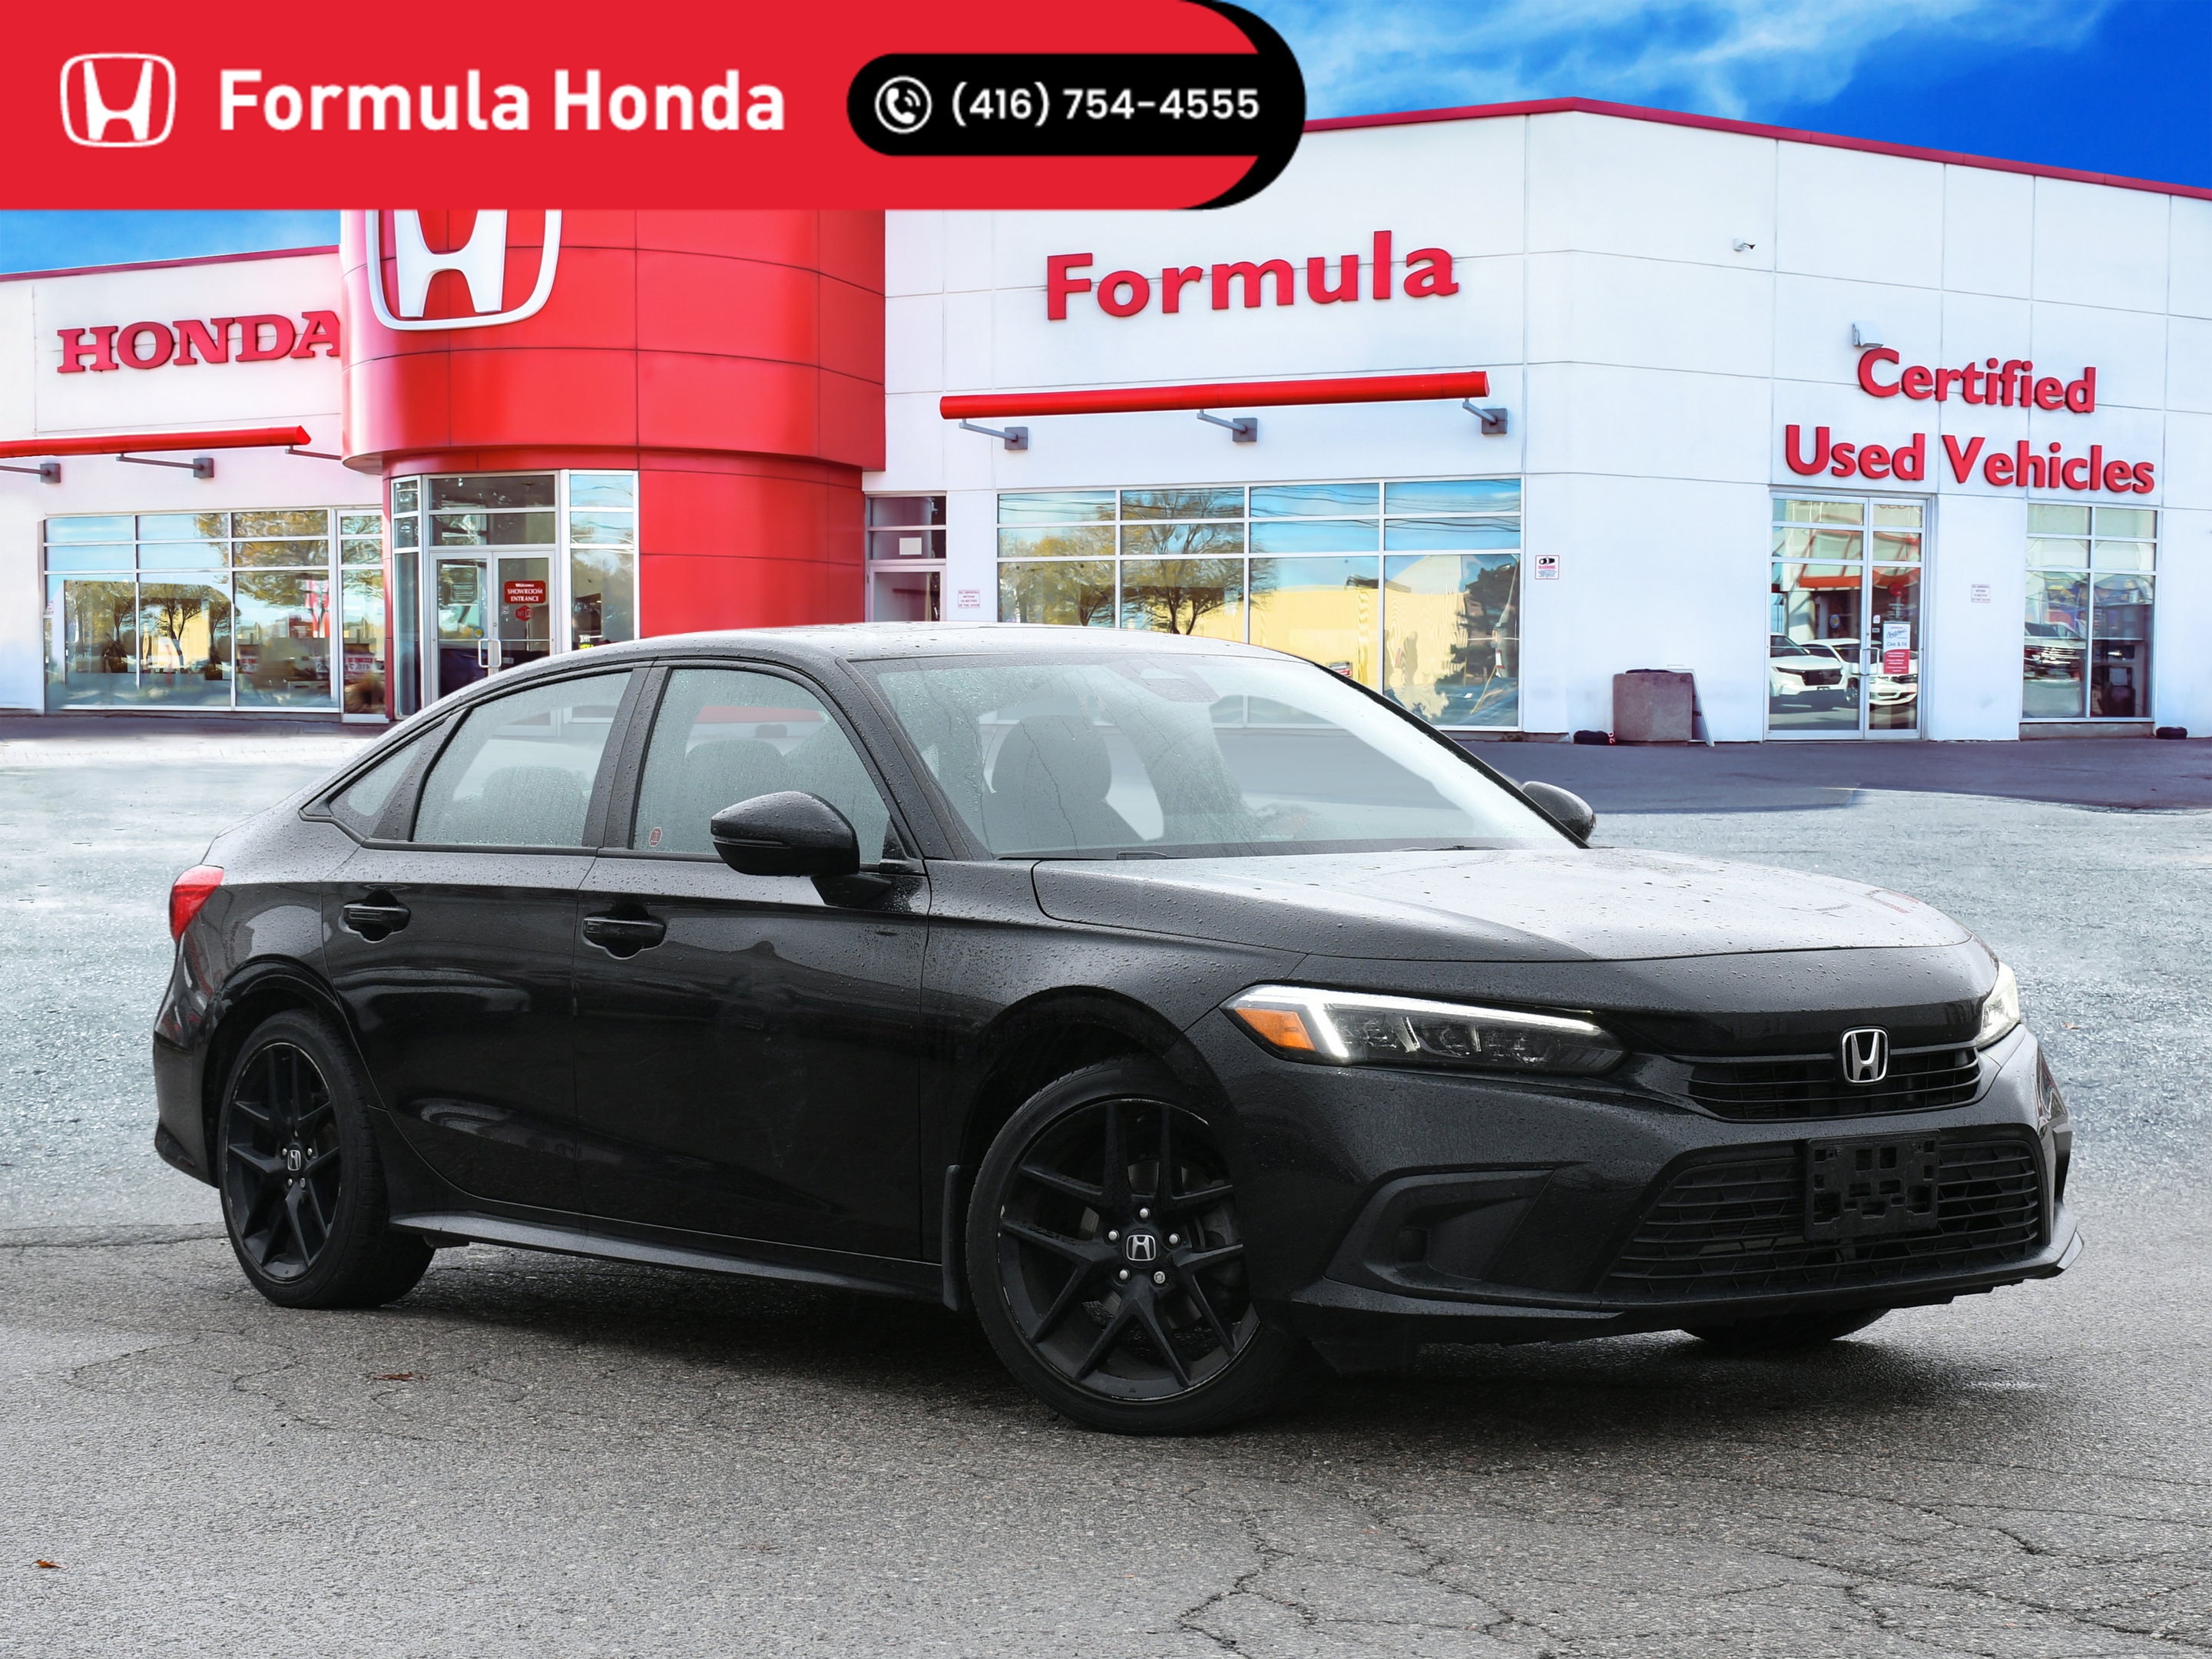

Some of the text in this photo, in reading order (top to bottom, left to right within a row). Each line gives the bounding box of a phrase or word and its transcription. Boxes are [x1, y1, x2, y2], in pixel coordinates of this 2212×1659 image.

[1048, 231, 1459, 320] Formula
[58, 310, 340, 373] HONDA
[1858, 348, 2096, 412] Certified
[1786, 425, 2154, 493] Used Vehicles
